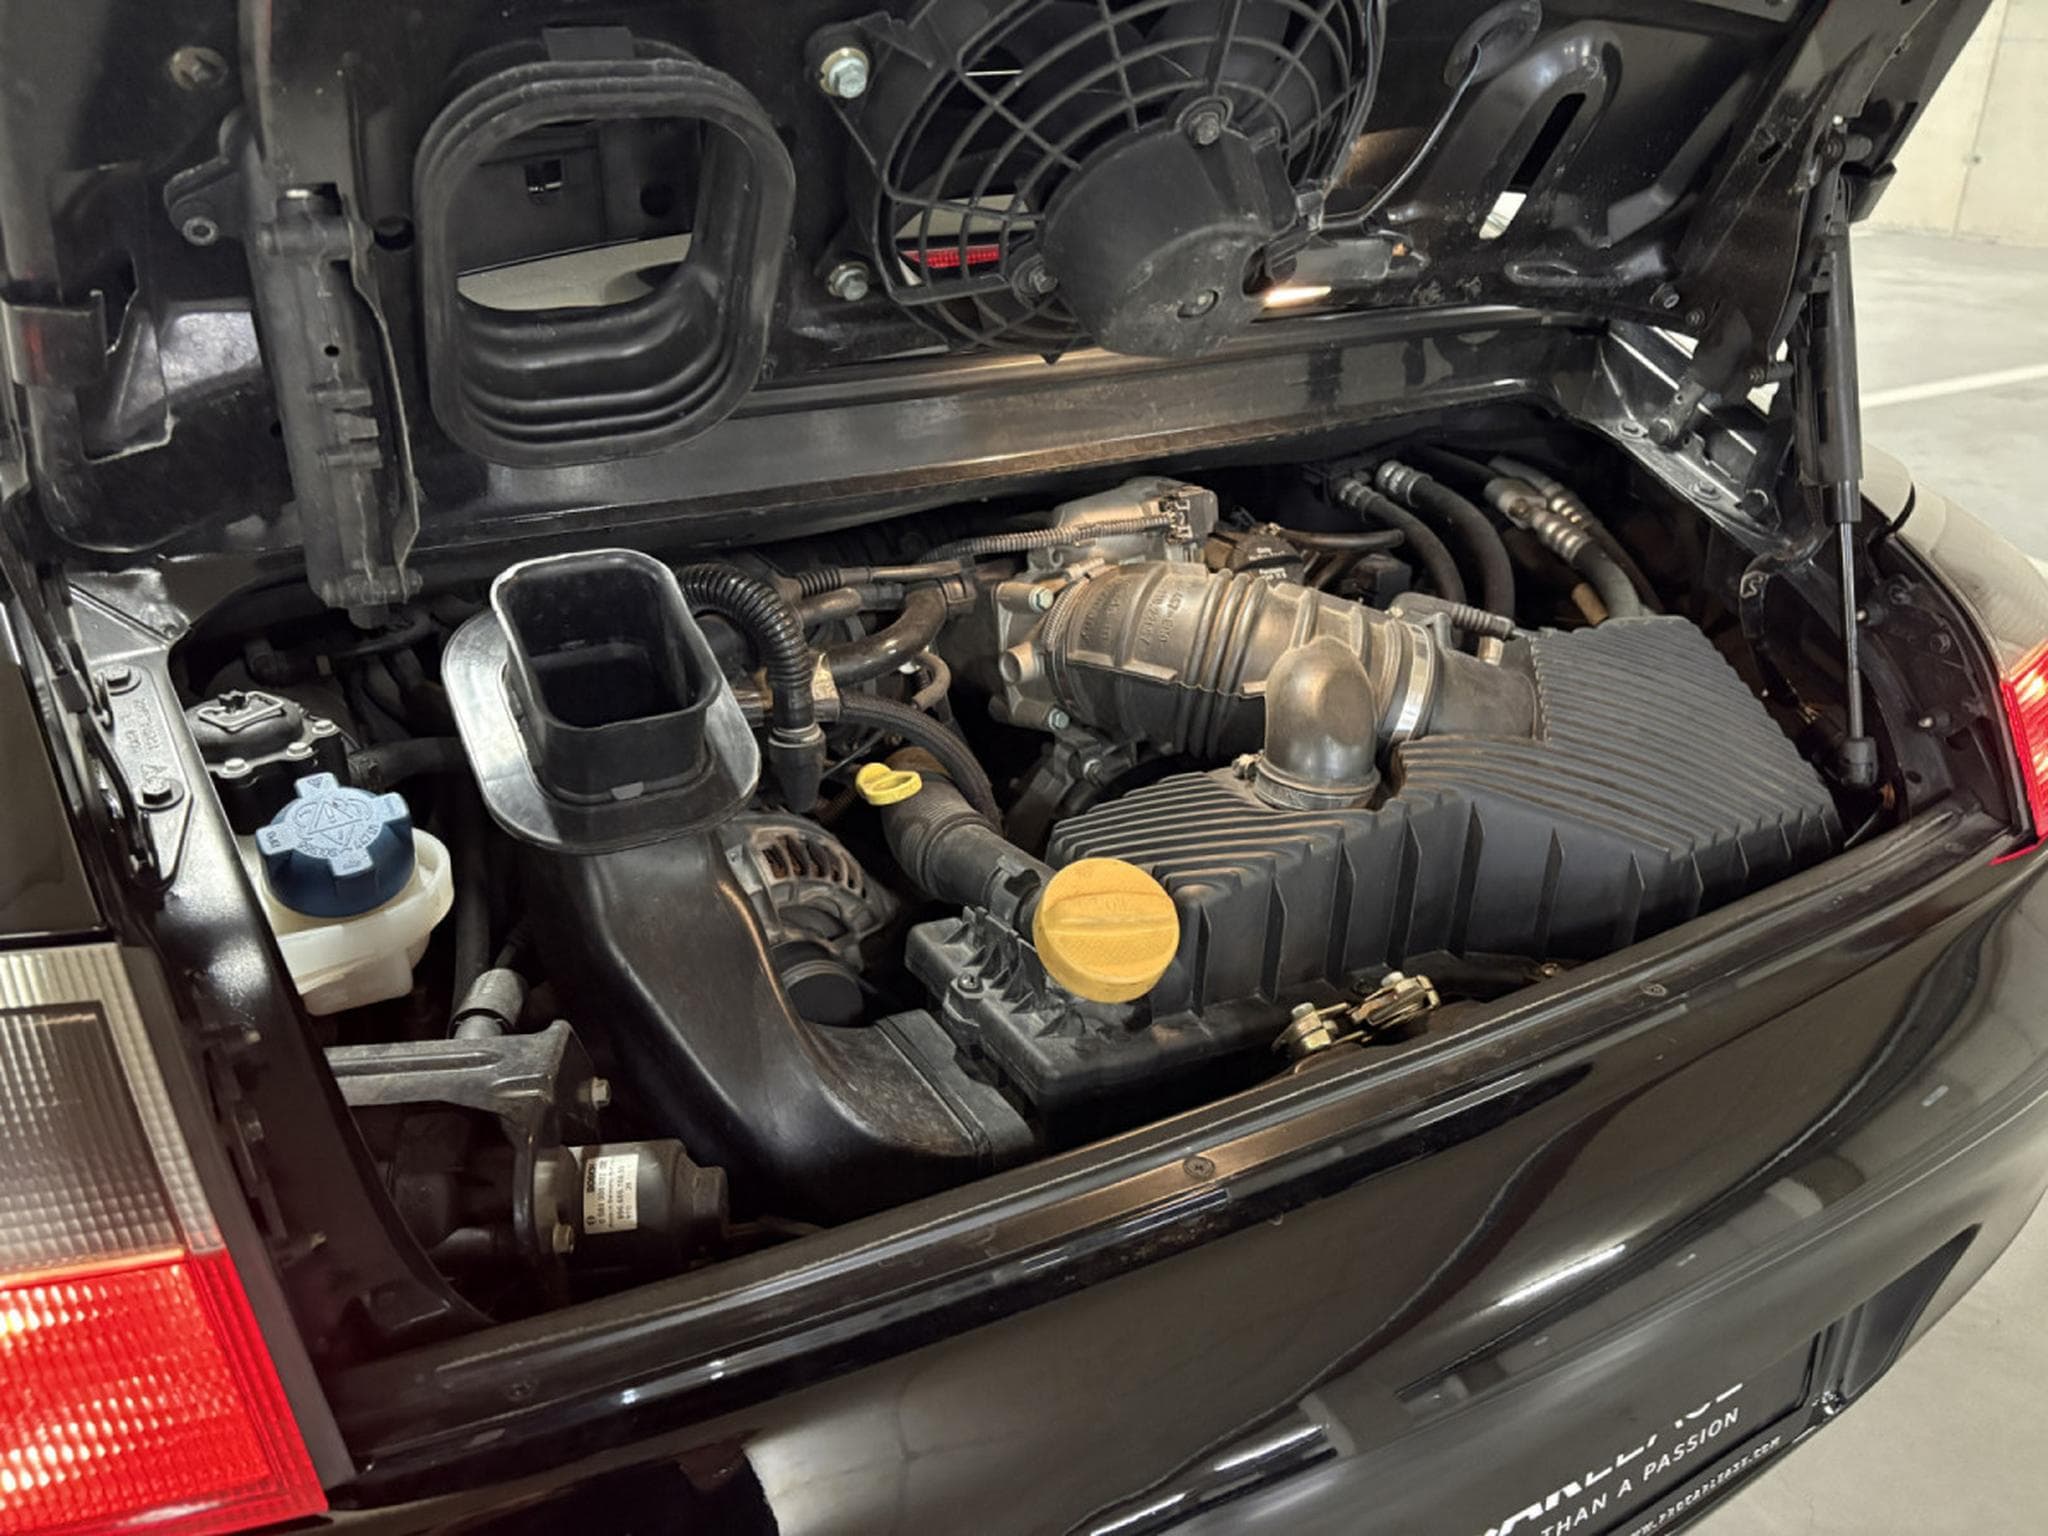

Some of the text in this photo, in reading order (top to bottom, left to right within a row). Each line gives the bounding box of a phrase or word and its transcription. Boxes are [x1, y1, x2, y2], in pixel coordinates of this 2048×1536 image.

[1541, 1407, 1740, 1536] THAN A PASSION
